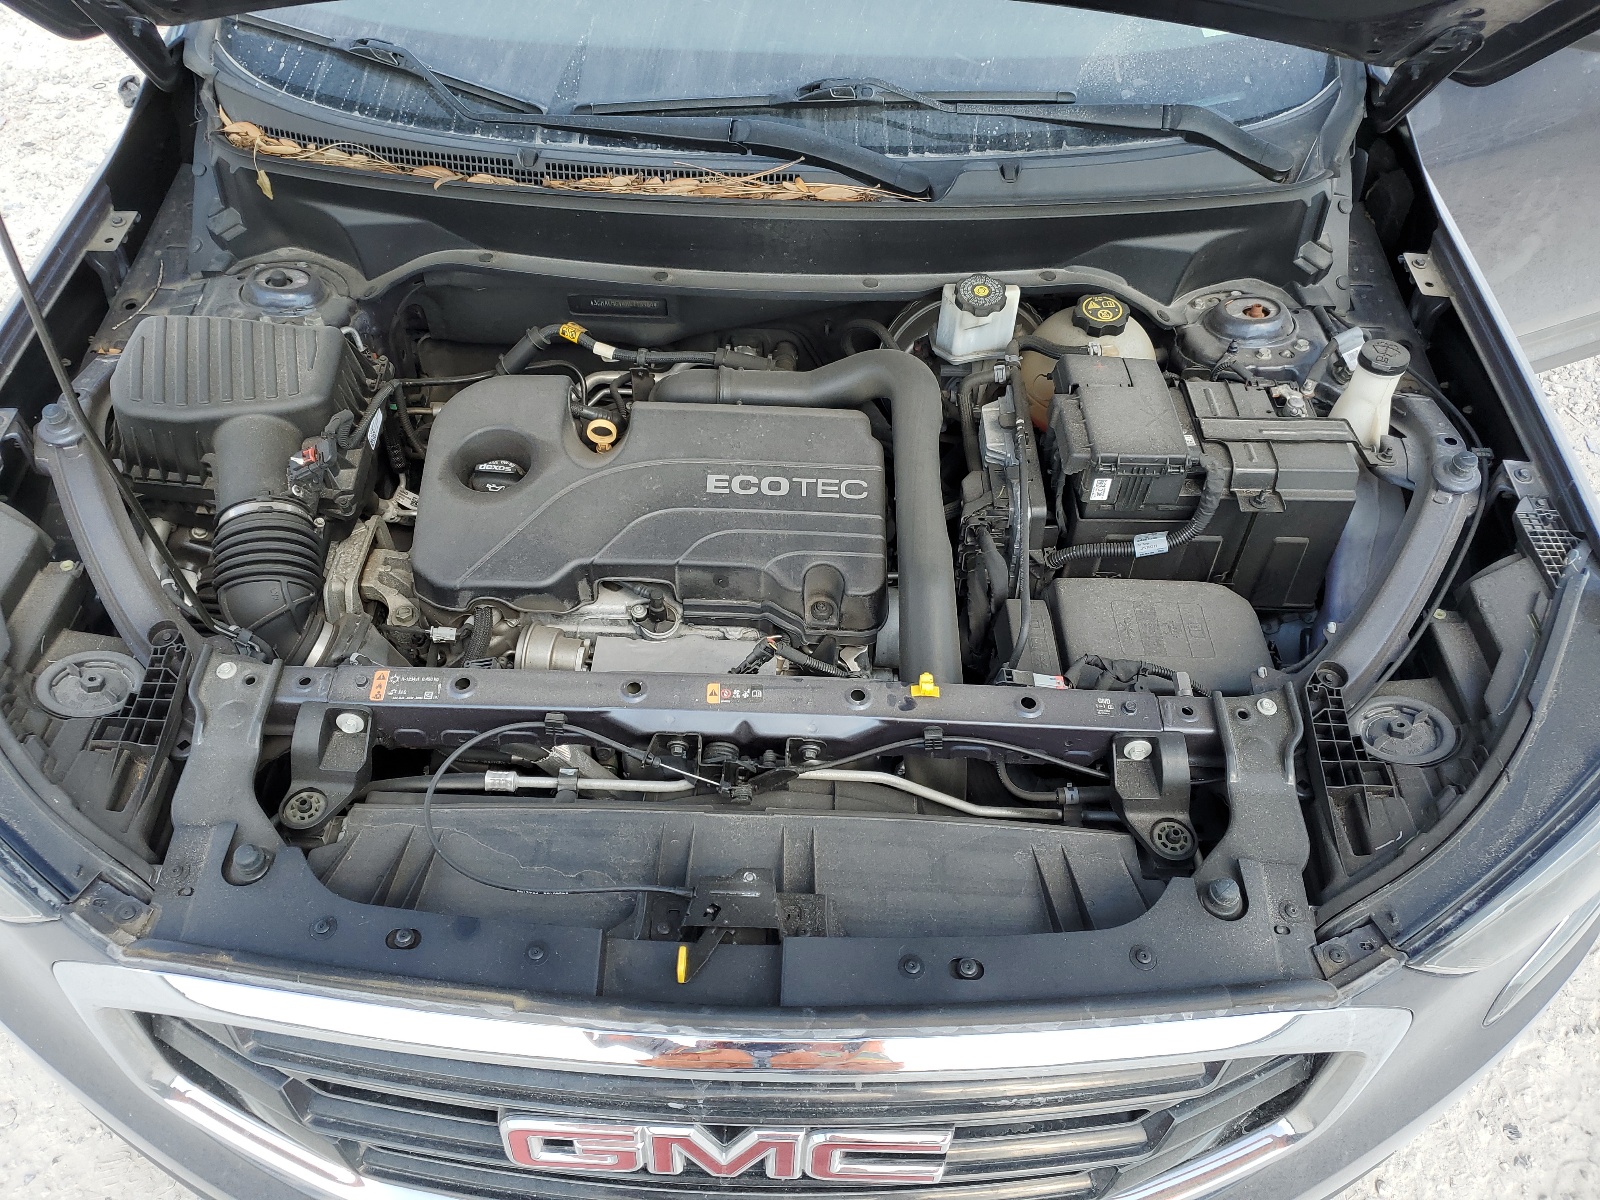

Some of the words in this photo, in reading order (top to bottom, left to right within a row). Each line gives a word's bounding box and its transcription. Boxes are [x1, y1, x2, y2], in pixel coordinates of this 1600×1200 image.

[479, 463, 511, 471] dexos
[706, 474, 869, 500] ECOTEC
[499, 1114, 955, 1184] GMC
